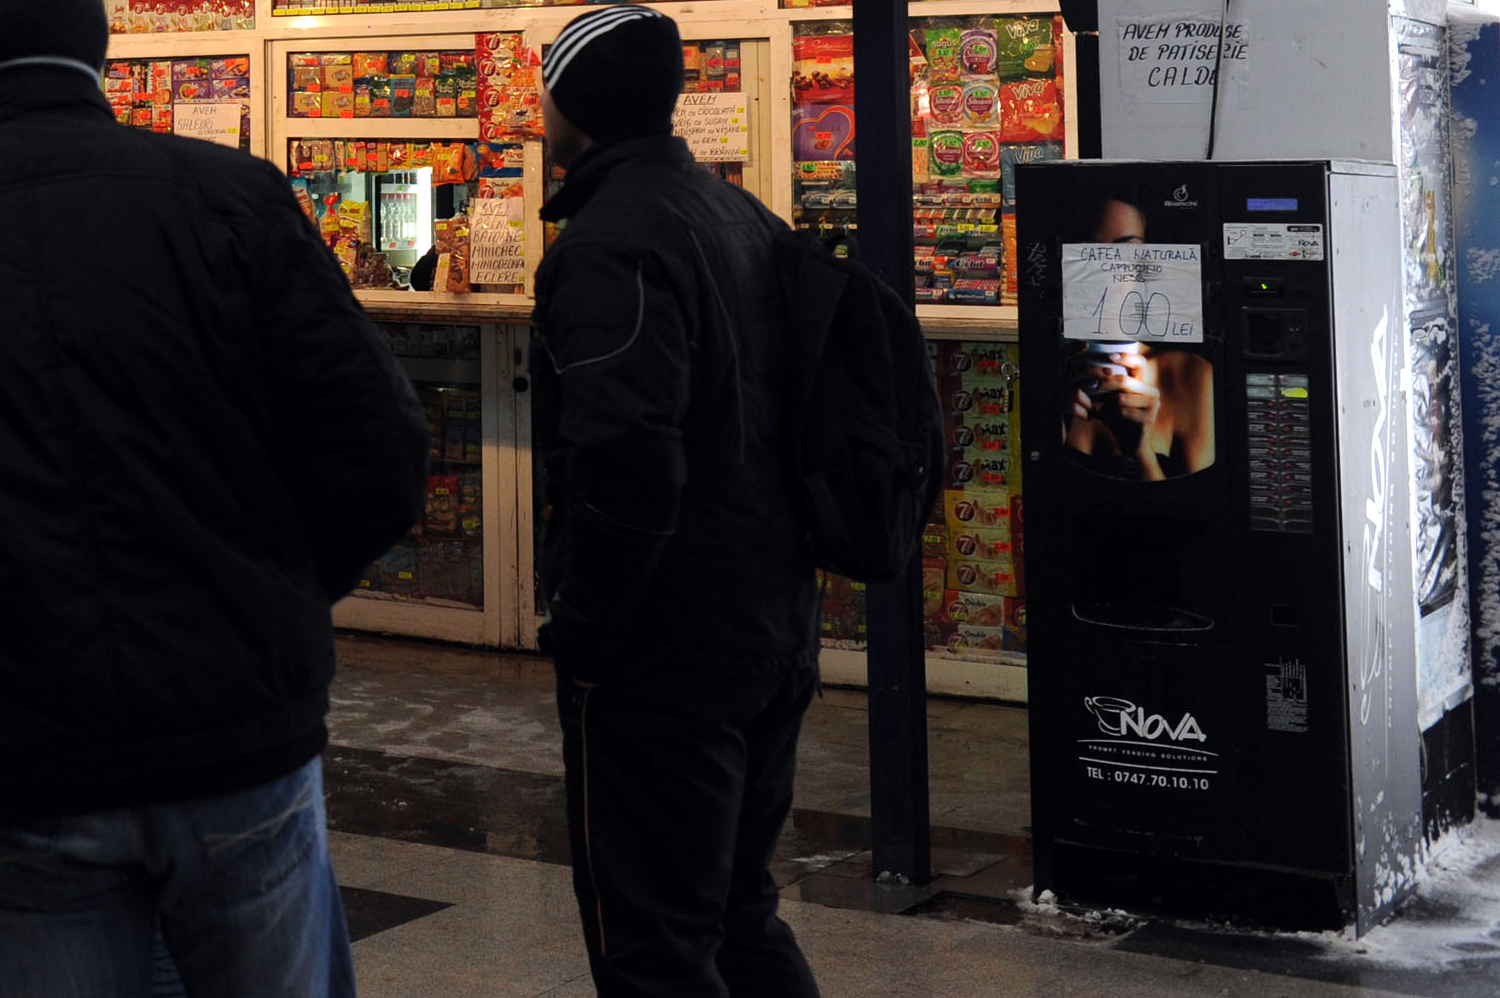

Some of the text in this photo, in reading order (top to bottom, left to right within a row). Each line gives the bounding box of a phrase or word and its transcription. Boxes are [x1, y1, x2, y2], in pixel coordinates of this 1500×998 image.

[1128, 46, 1149, 61] DE
[1080, 247, 1121, 261] CAFEA
[1172, 322, 1194, 336] LEI
[1120, 706, 1207, 742] NOVA
[1114, 771, 1210, 790] 0747.70.10.10
